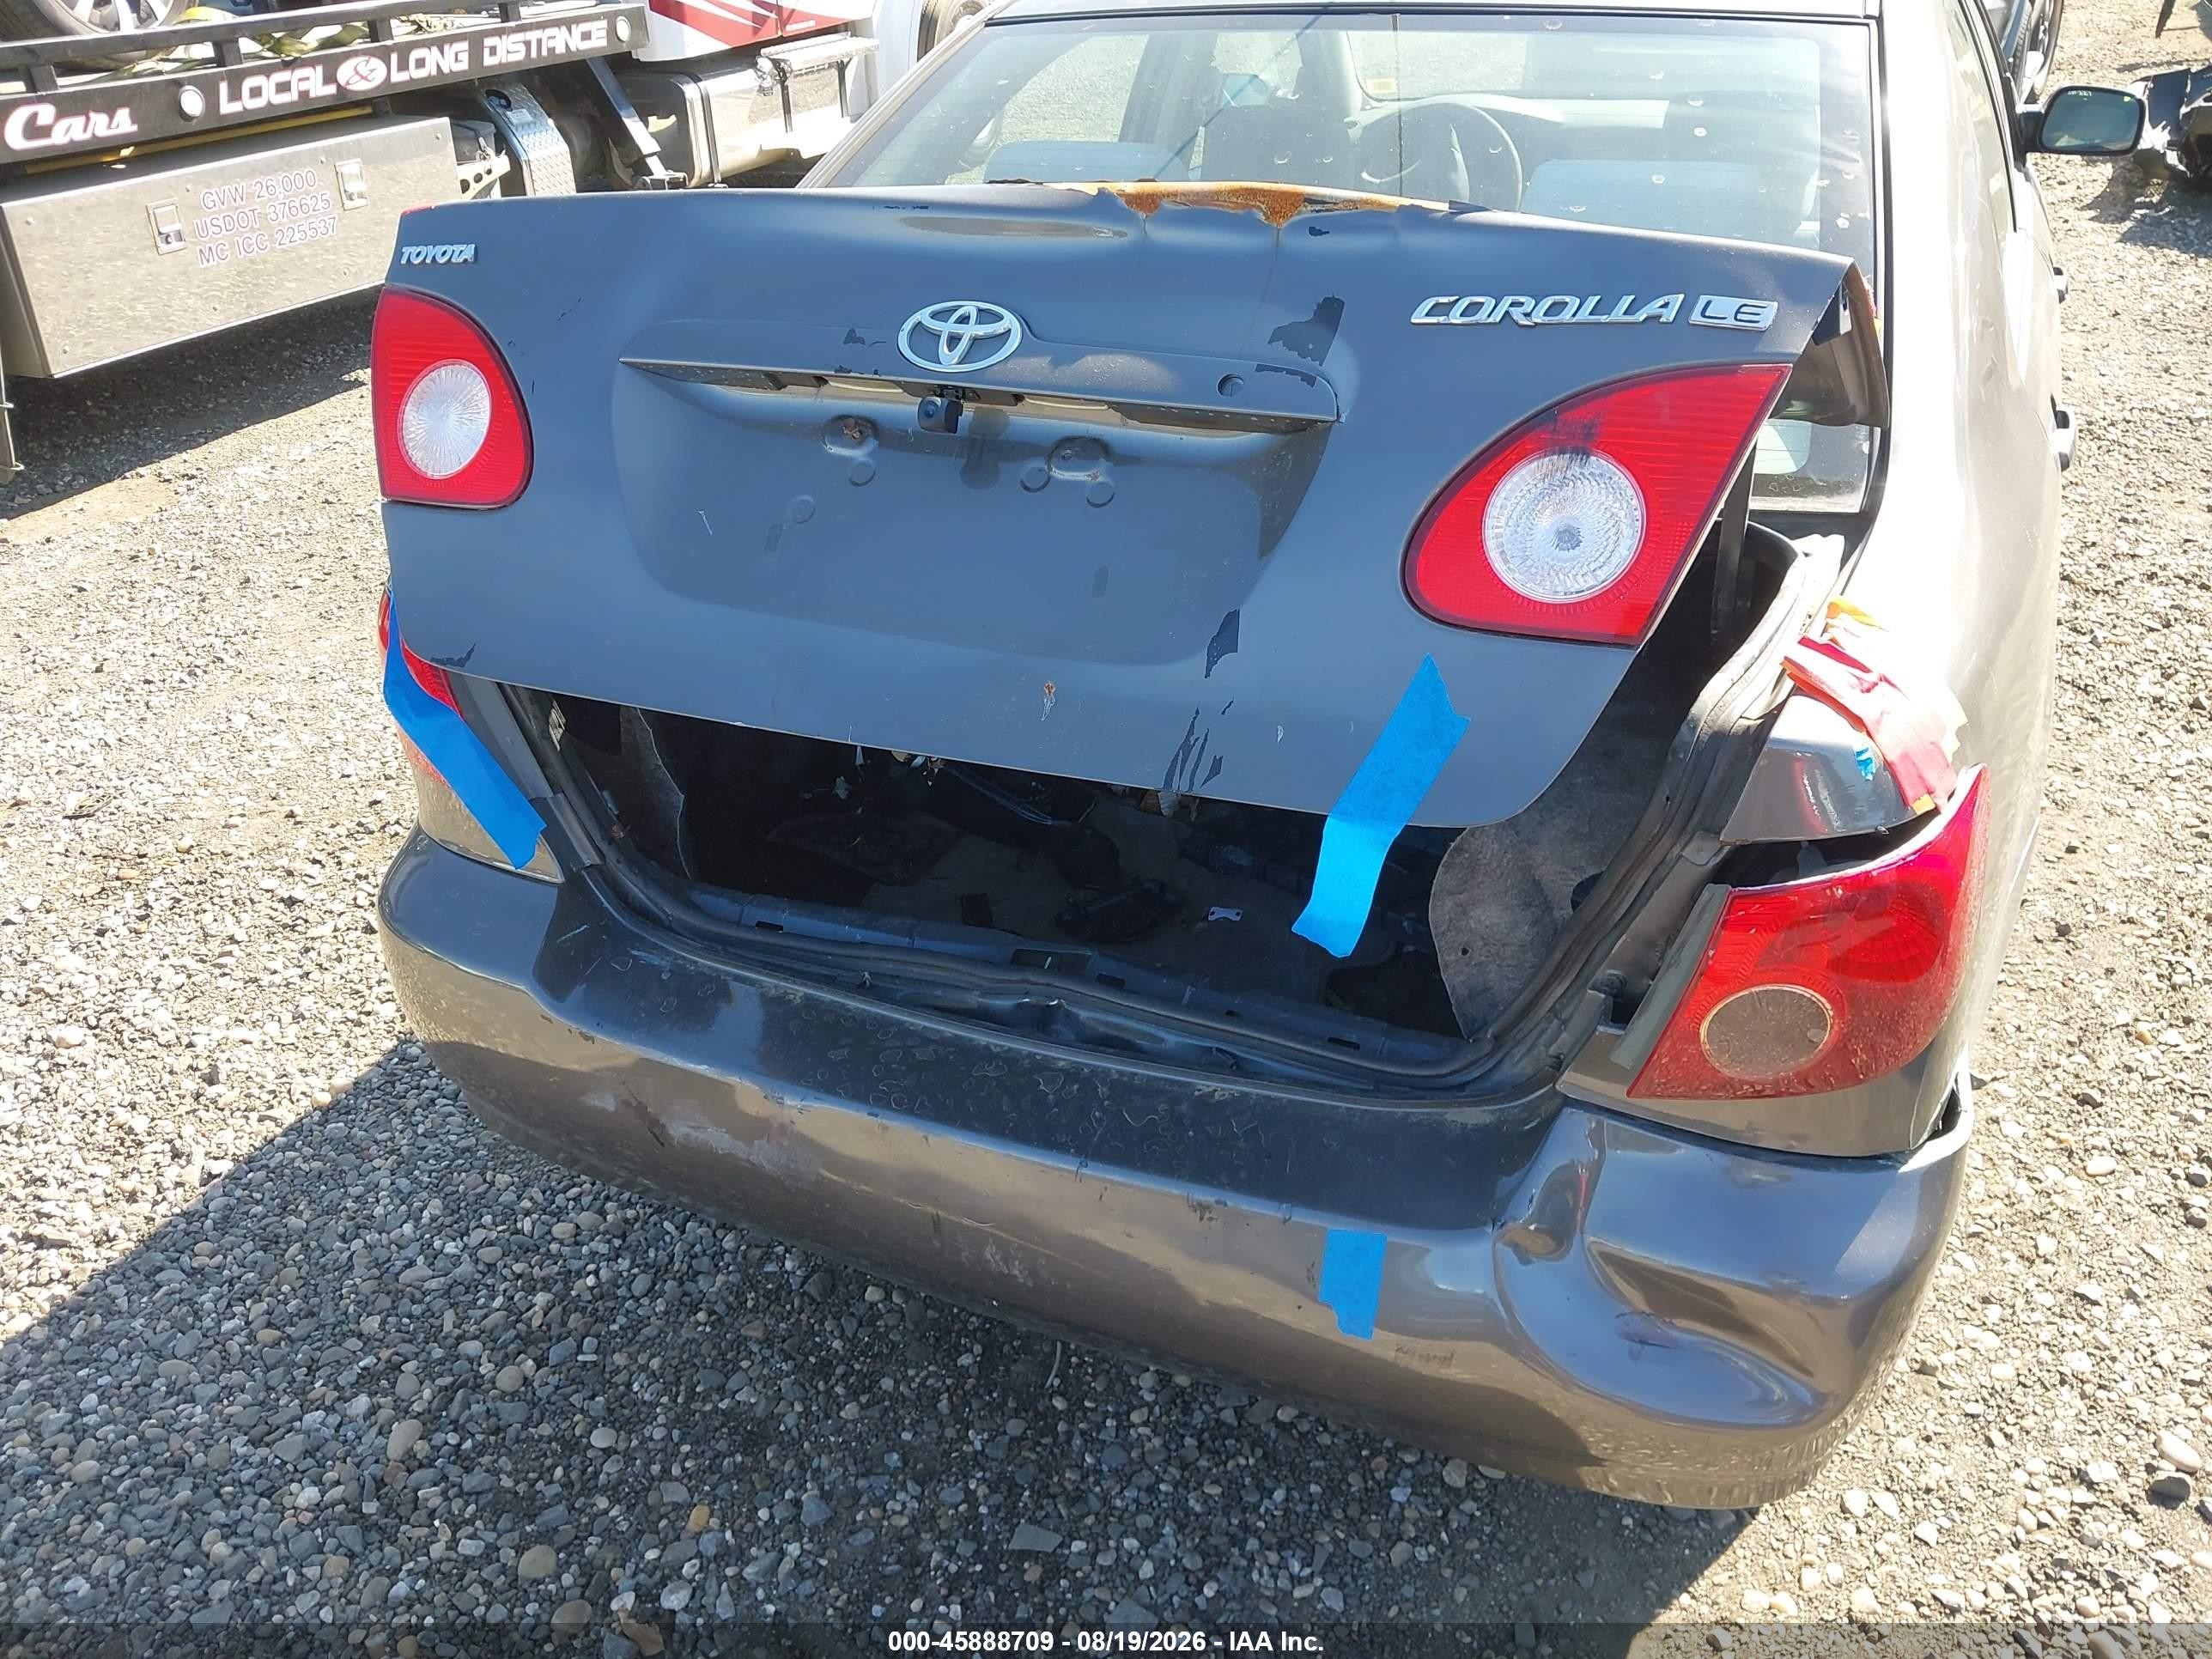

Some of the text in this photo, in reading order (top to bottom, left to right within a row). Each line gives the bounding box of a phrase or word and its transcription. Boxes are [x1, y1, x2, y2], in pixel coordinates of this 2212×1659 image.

[219, 19, 609, 115] LOCAL & LONG DISTANCE
[4, 102, 139, 151] Cars
[195, 193, 331, 238] USDOT 376625
[202, 185, 245, 210] GVW
[198, 216, 337, 265] MC ICC 225537
[400, 244, 476, 264] TOYOTA
[1410, 294, 1772, 327] COROLLA LE
